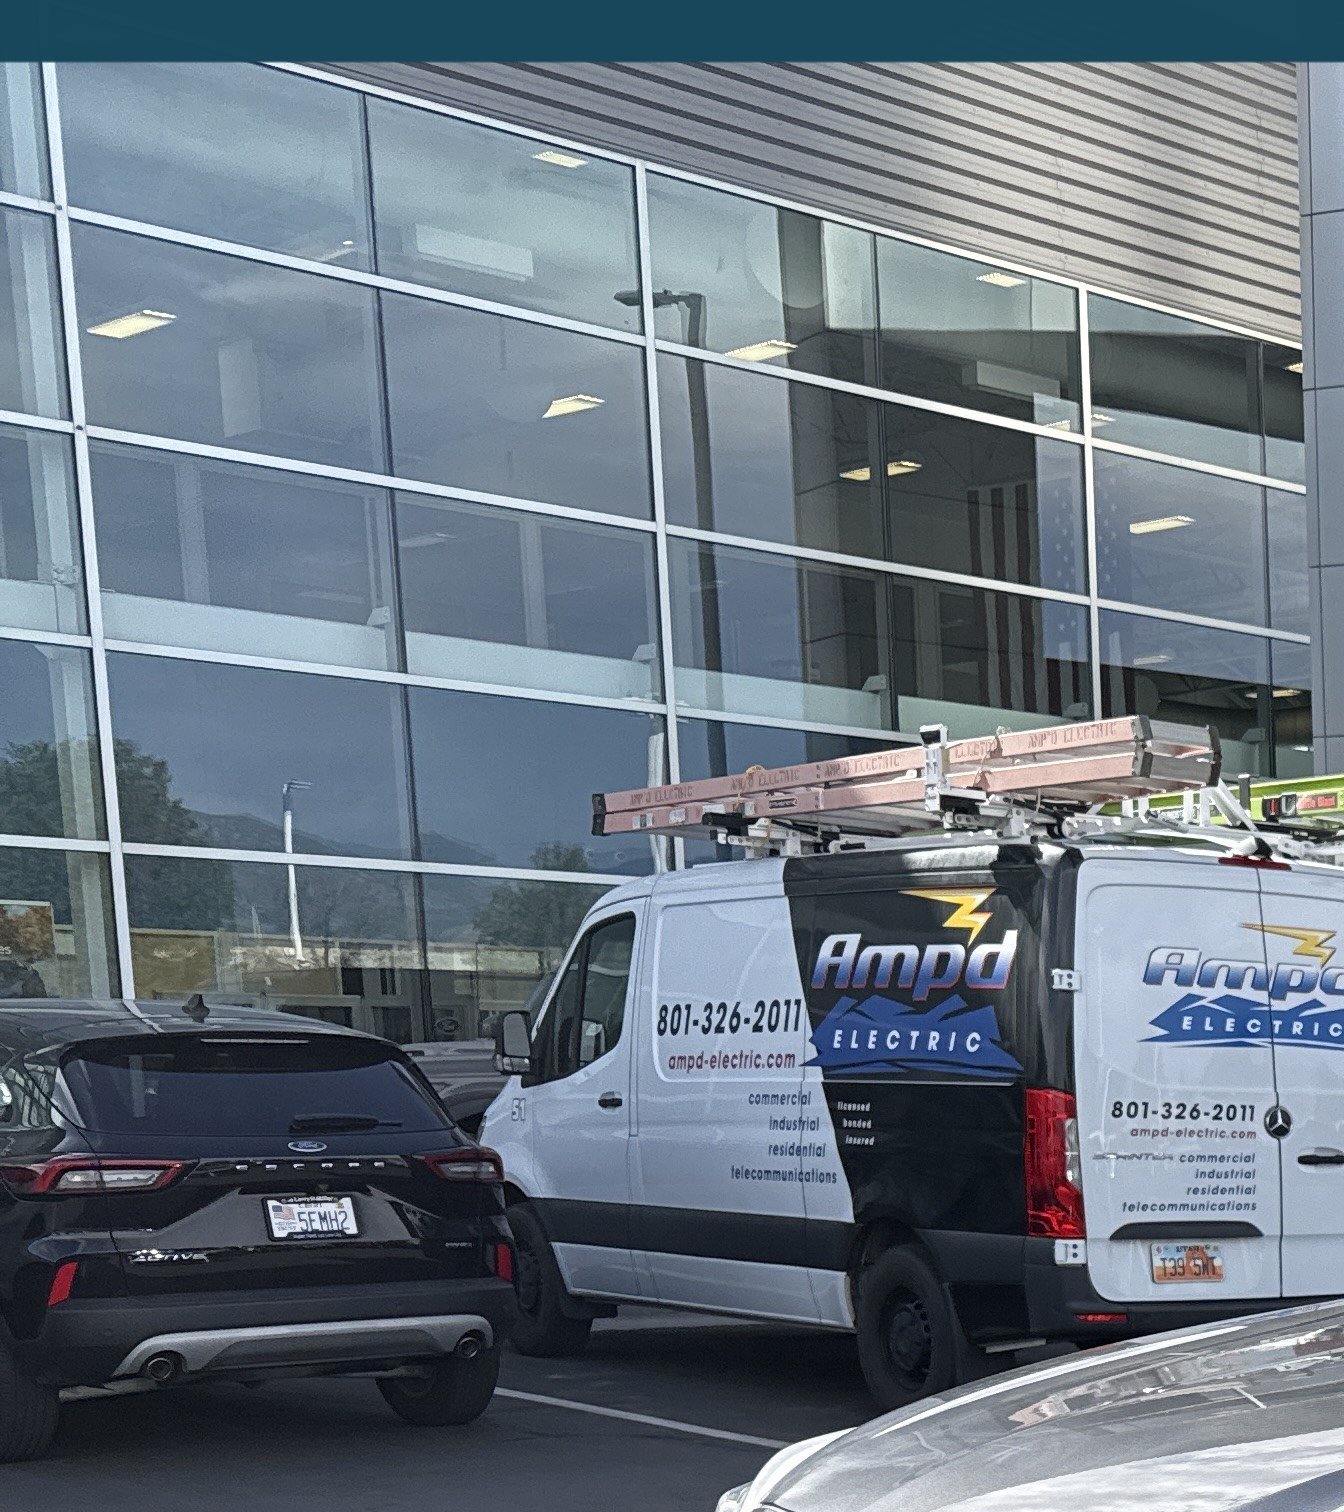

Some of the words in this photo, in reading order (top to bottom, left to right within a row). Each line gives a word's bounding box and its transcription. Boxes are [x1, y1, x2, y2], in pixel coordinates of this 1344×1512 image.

[811, 929, 1018, 1001] Ampd
[657, 999, 802, 1036] 801-326-2011
[1182, 1015, 1343, 1037] ELECTRIC
[833, 1029, 981, 1053] ELECTRIC
[668, 1050, 796, 1073] ampd-electric.com
[749, 1091, 811, 1106] commercial
[511, 1098, 526, 1122] 51
[837, 1101, 871, 1112] licensed
[1111, 1101, 1256, 1122] 801-326-2011
[769, 1116, 820, 1131] industrial
[843, 1118, 872, 1129] bonded
[845, 1135, 875, 1146] insured
[1130, 1127, 1257, 1140] ampd-electric.com
[768, 1142, 827, 1158] residential
[1179, 1153, 1256, 1163] commercial
[731, 1165, 838, 1184] telecommunications
[1195, 1168, 1256, 1179] industrial
[1186, 1184, 1257, 1195] residential
[1122, 1200, 1257, 1212] telecommunications
